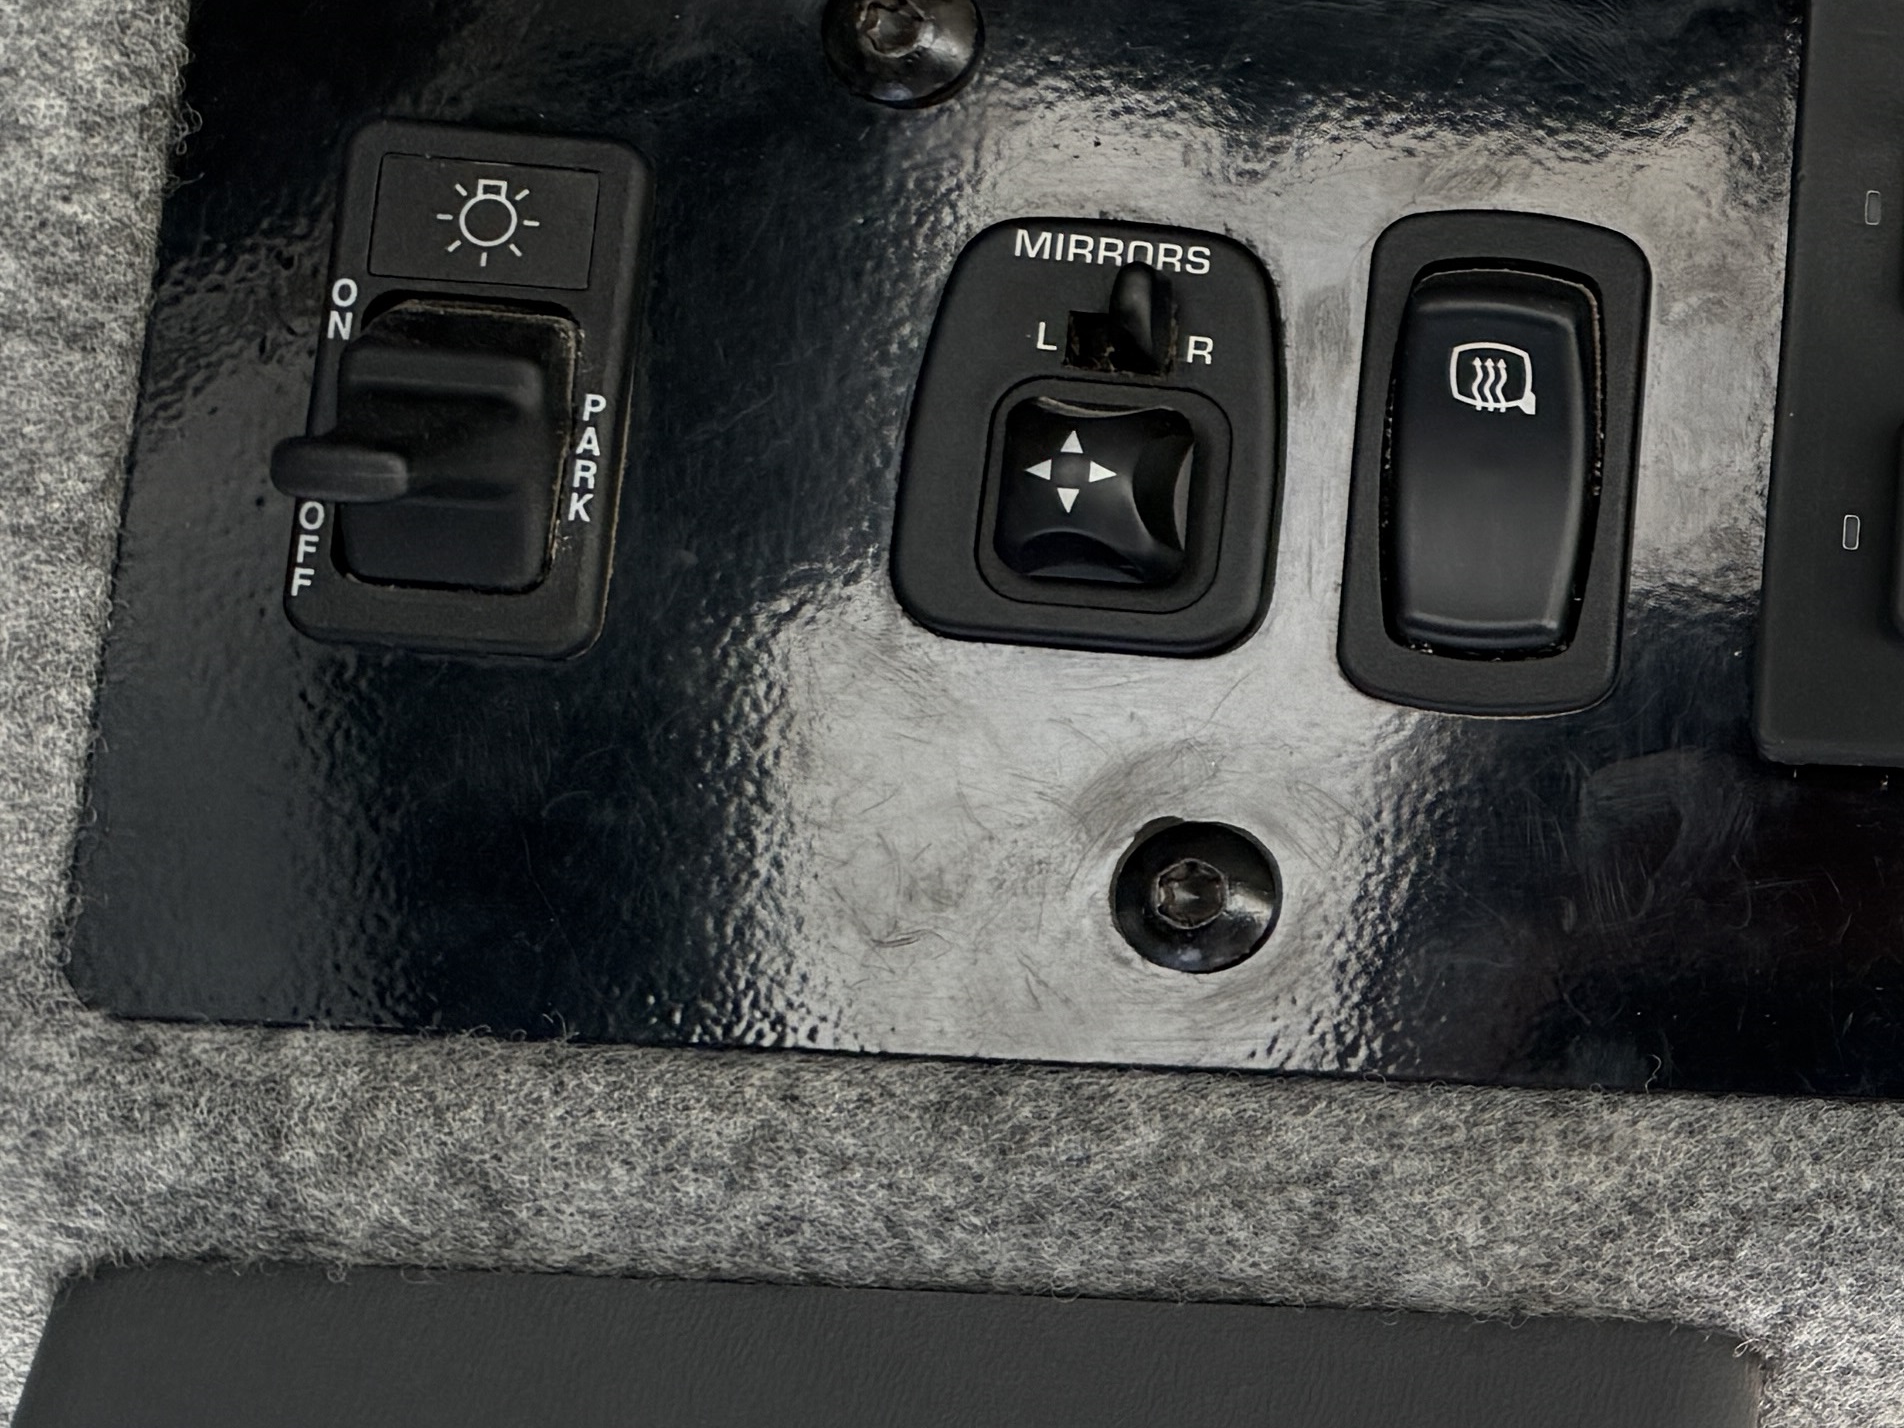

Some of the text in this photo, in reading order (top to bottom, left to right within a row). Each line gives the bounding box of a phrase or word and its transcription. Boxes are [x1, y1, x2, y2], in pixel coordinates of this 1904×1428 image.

[1013, 228, 1211, 274] MIRRORS
[326, 278, 359, 340] ON
[1035, 321, 1058, 352] L
[1187, 336, 1214, 366] R
[567, 393, 607, 523] PARK
[290, 500, 326, 597] OFF
